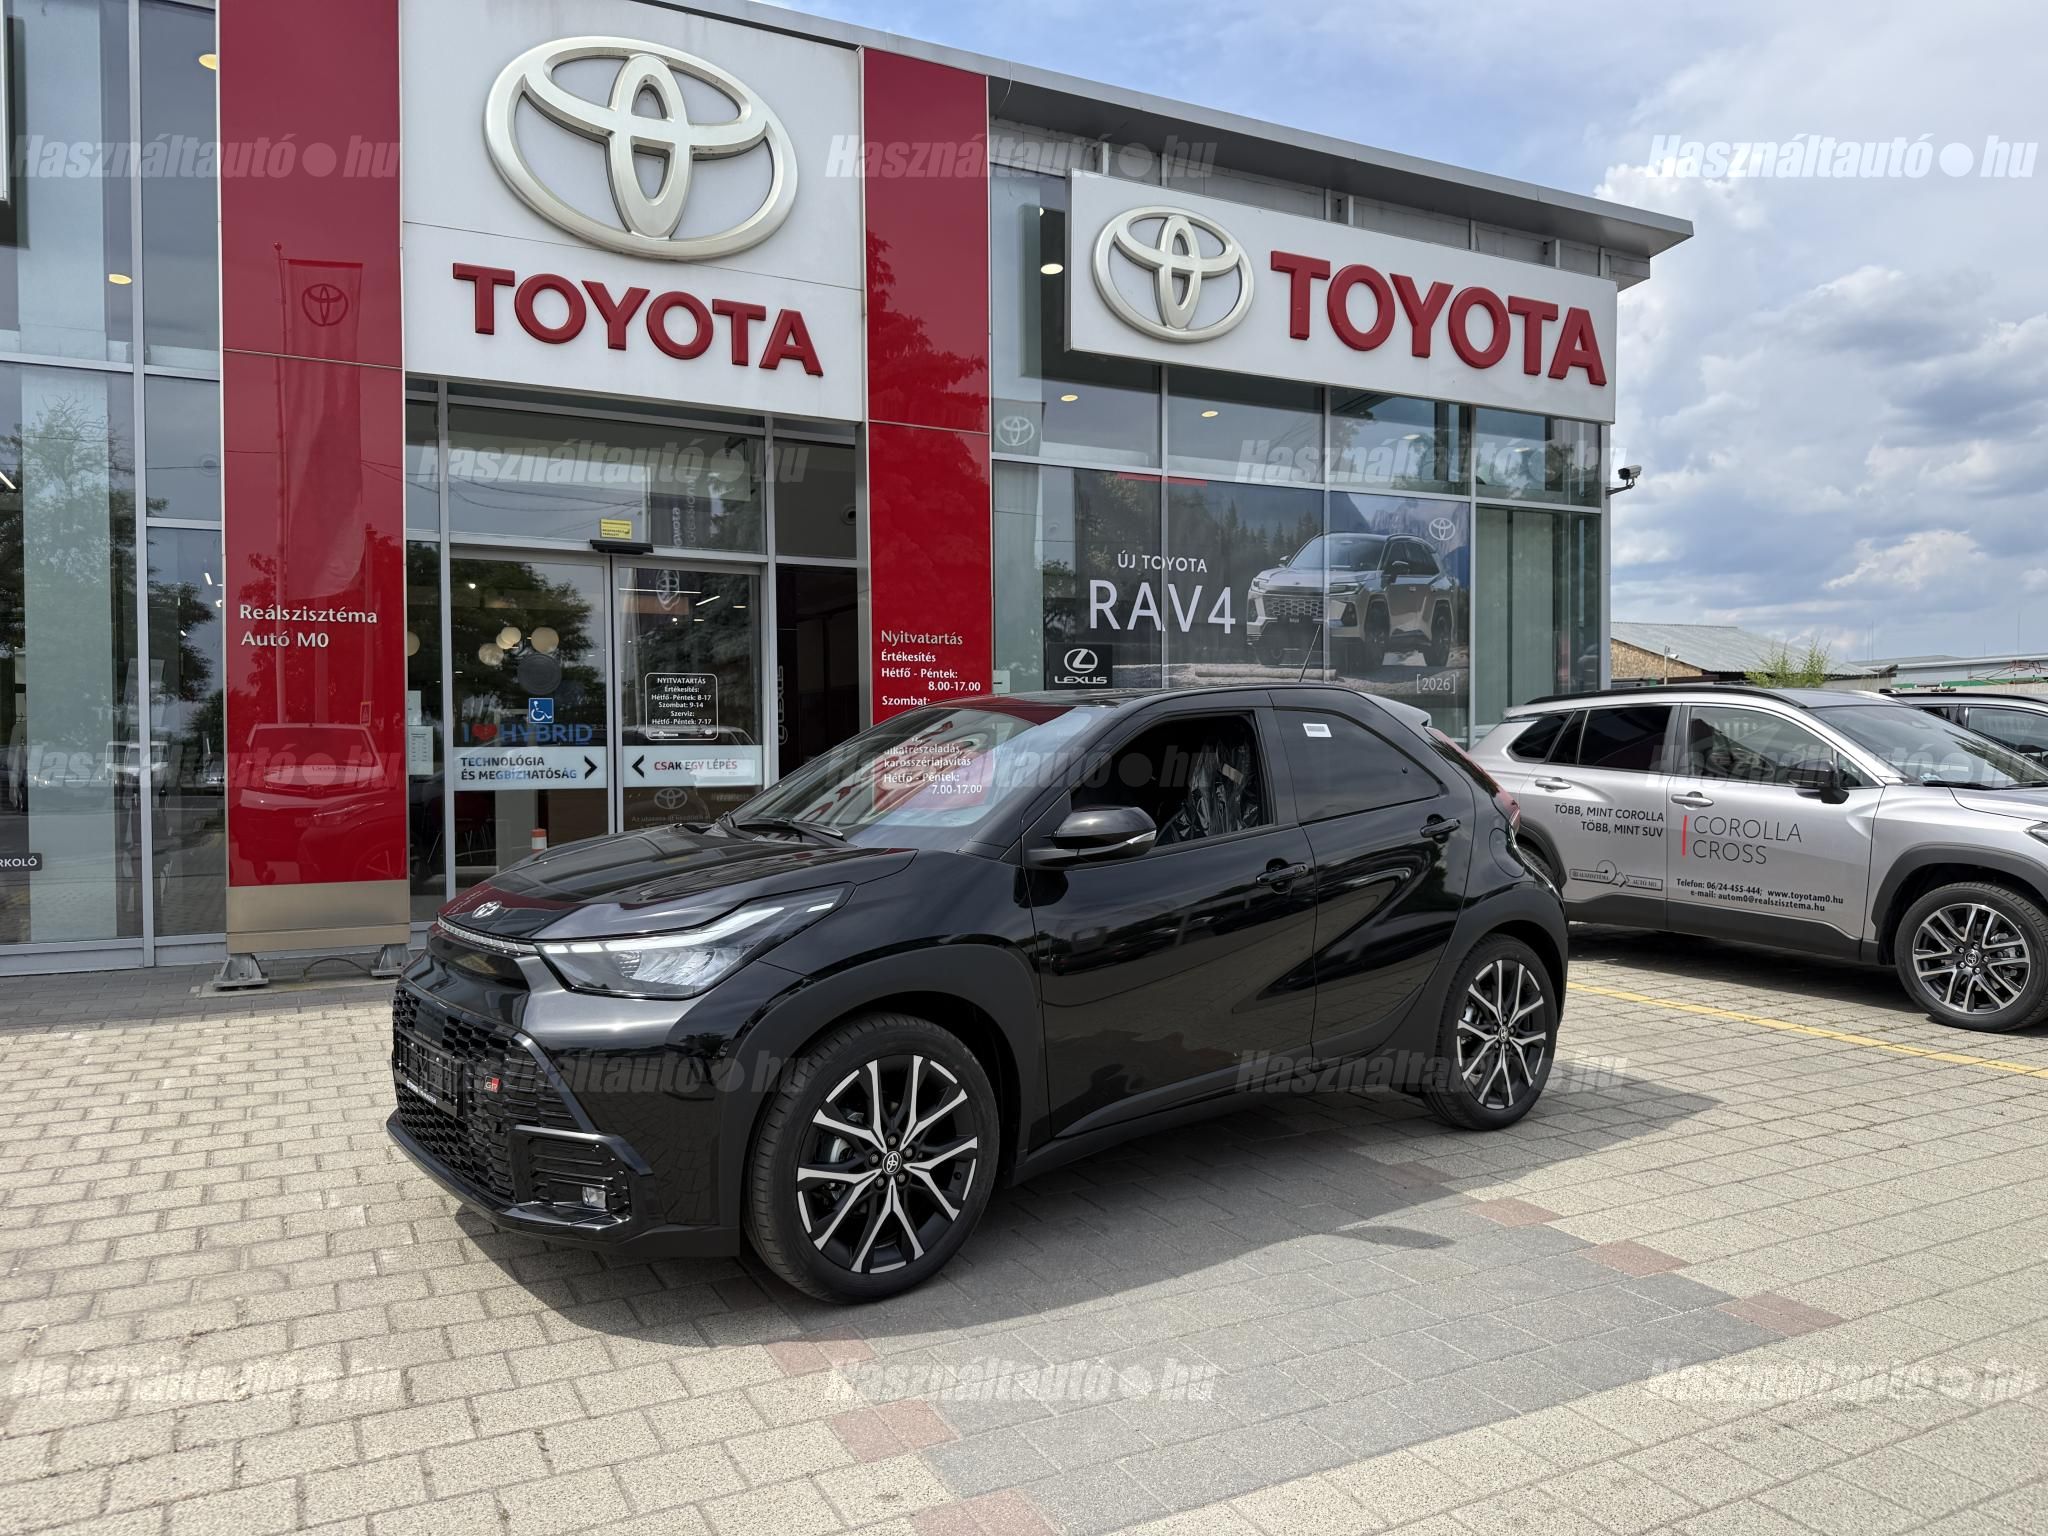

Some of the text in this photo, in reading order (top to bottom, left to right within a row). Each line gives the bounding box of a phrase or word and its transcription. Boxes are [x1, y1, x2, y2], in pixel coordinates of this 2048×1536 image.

[453, 262, 823, 376] TOYOTA
[1271, 250, 1607, 386] TOYOTA
[1118, 550, 1208, 573] ÚJ TOYOTA
[240, 604, 377, 623] Reálszisztéma
[1089, 579, 1236, 635] RAV4
[241, 631, 290, 647] Autó
[881, 630, 963, 646] Nyitvatartás
[881, 649, 936, 662] Értékesítés
[881, 667, 911, 678] Hétfő
[921, 668, 958, 678] Péntek:
[1054, 675, 1107, 684] LEXUS
[928, 682, 981, 691] 8.00-17.00
[501, 723, 593, 743] HYBRID
[461, 755, 545, 767] TECHNOLÓGIA
[654, 758, 737, 770] CSAK EGY LÉPÉS
[461, 767, 577, 781] ÉS MEGBÍZHATÓSÁG
[884, 773, 913, 783] Hétfő
[922, 772, 960, 782] Péntek:
[931, 784, 982, 794] 7.00-17.00
[1555, 803, 1664, 822] TÖBB, MINT COROLLA
[1581, 820, 1664, 837] TÖBB, MINT SUV
[1694, 815, 1802, 842] COROLLA
[1692, 840, 1767, 864] CROSS
[1676, 878, 1705, 889] Telefon:
[1767, 890, 1844, 904] www.toyotam0.hu
[1690, 890, 1716, 899] e-mail:
